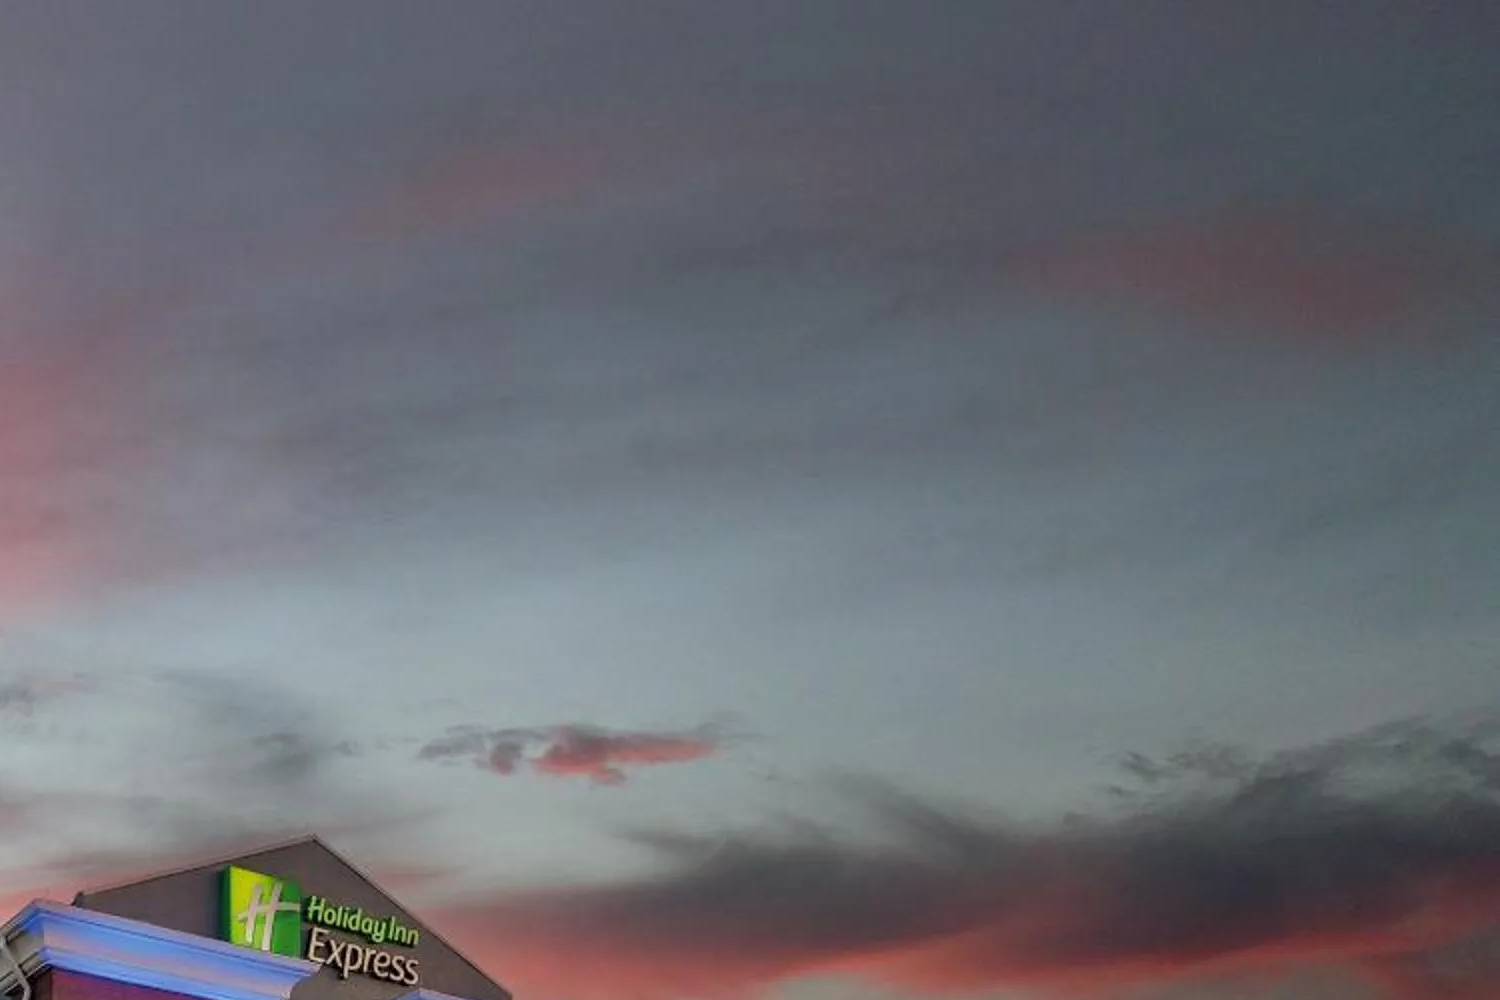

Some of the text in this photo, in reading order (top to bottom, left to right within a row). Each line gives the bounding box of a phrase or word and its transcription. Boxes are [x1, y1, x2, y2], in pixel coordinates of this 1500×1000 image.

[308, 896, 420, 946] Holiday Inn
[308, 926, 420, 986] Express
